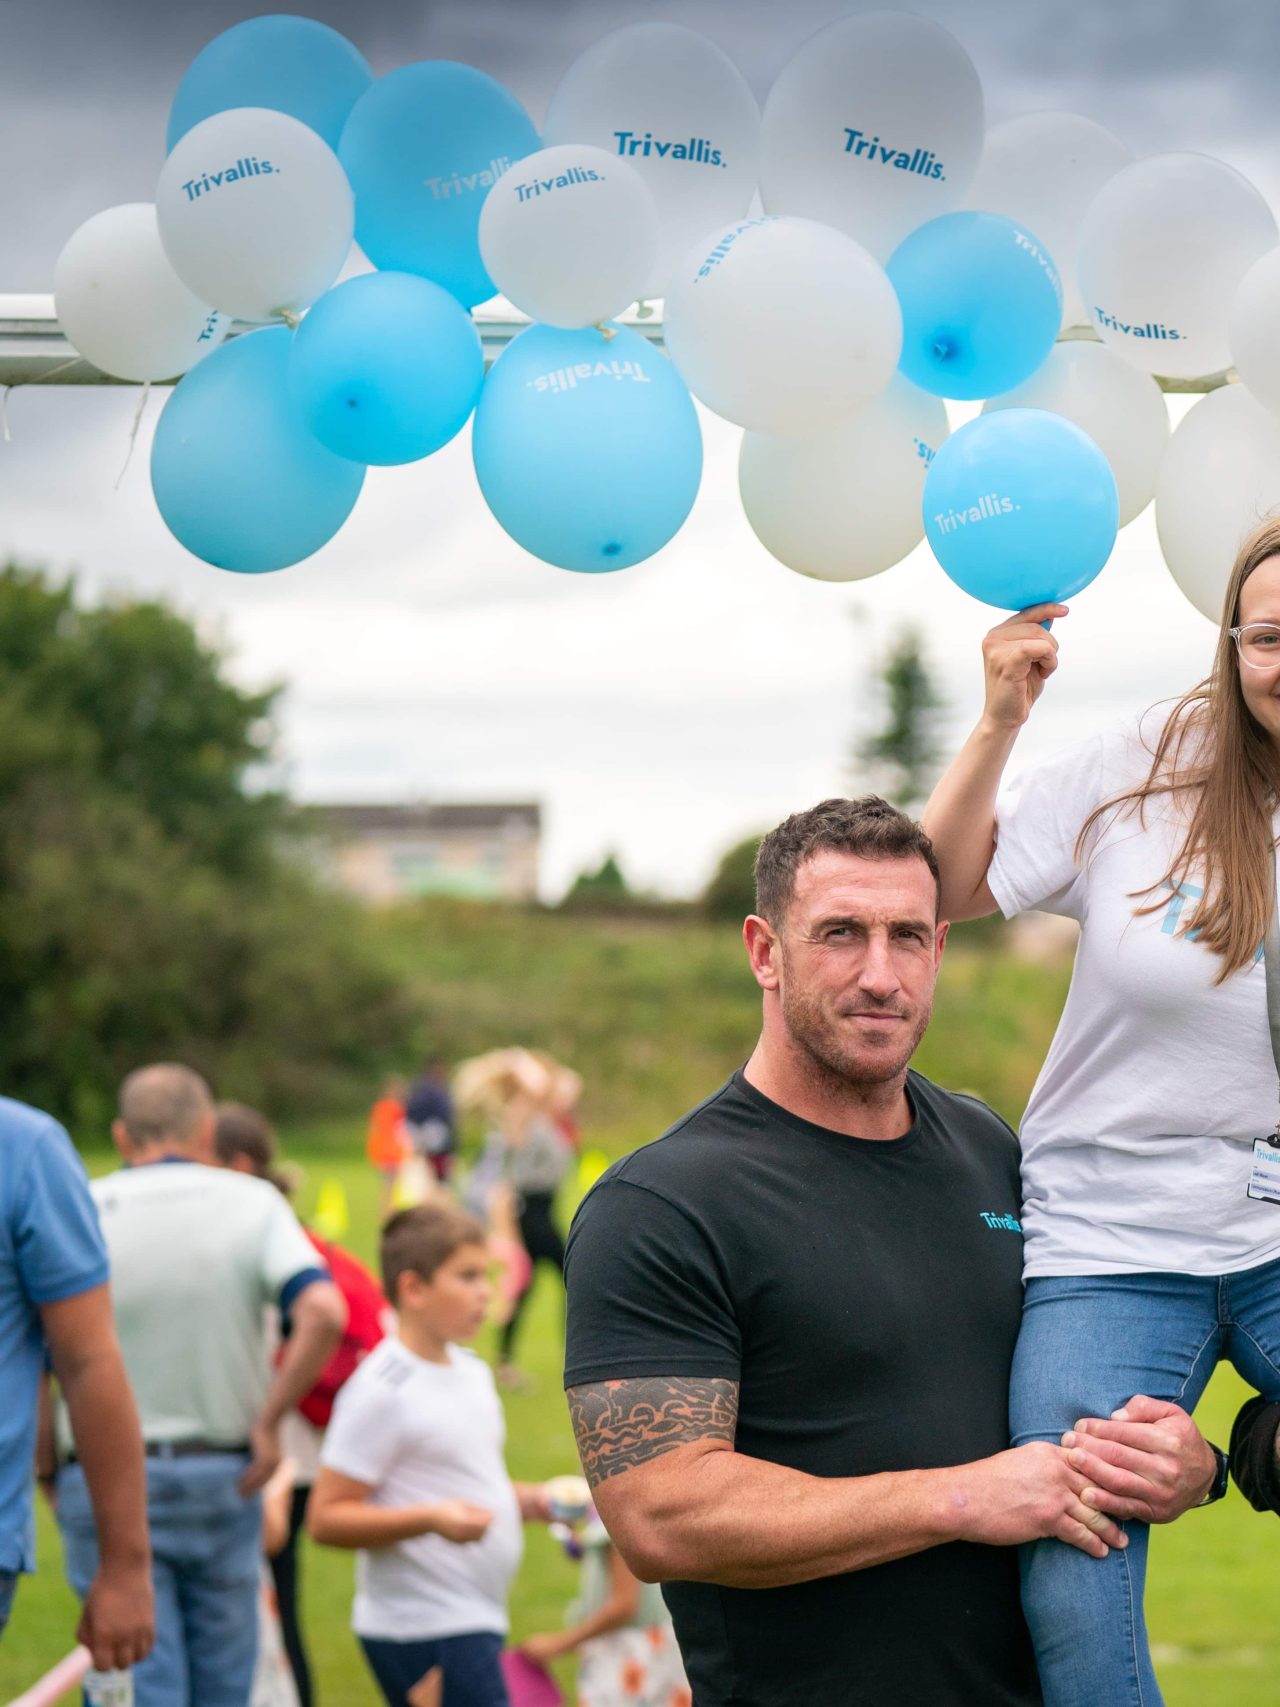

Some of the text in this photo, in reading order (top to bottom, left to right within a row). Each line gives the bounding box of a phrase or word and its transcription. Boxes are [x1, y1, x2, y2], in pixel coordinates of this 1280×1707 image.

[613, 131, 727, 168] Trivallis.
[843, 127, 946, 181] Trivallis.
[182, 156, 280, 202] Trivallis.
[513, 166, 606, 202] Trivallis.
[1094, 306, 1187, 340] Trivallis.
[526, 360, 651, 393] Trivallis.
[935, 493, 1022, 535] Trivallis.
